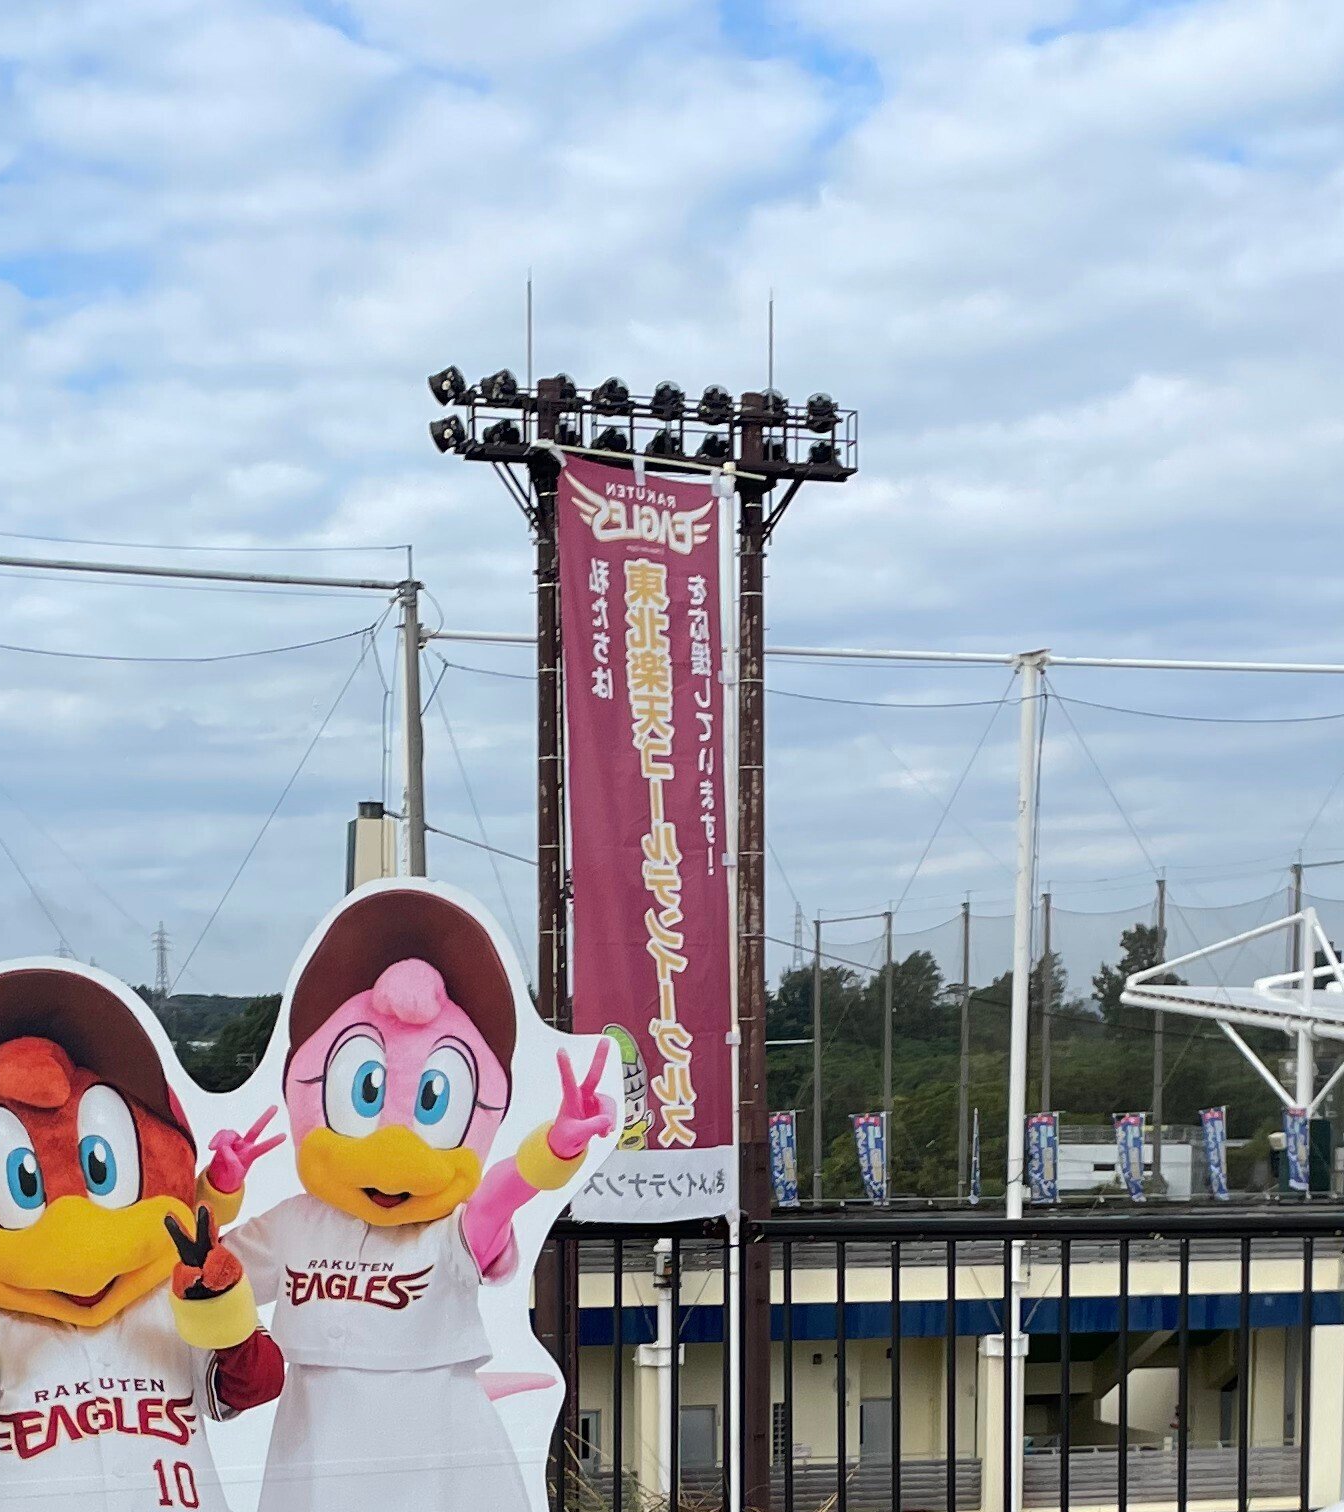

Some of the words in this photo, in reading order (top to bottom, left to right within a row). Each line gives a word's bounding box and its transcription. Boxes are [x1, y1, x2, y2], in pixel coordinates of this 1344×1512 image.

[307, 1259, 395, 1272] RAKUTEN
[285, 1264, 434, 1310] EAGLES
[34, 1377, 166, 1404] RAKUTEN
[152, 1458, 201, 1510] 10
